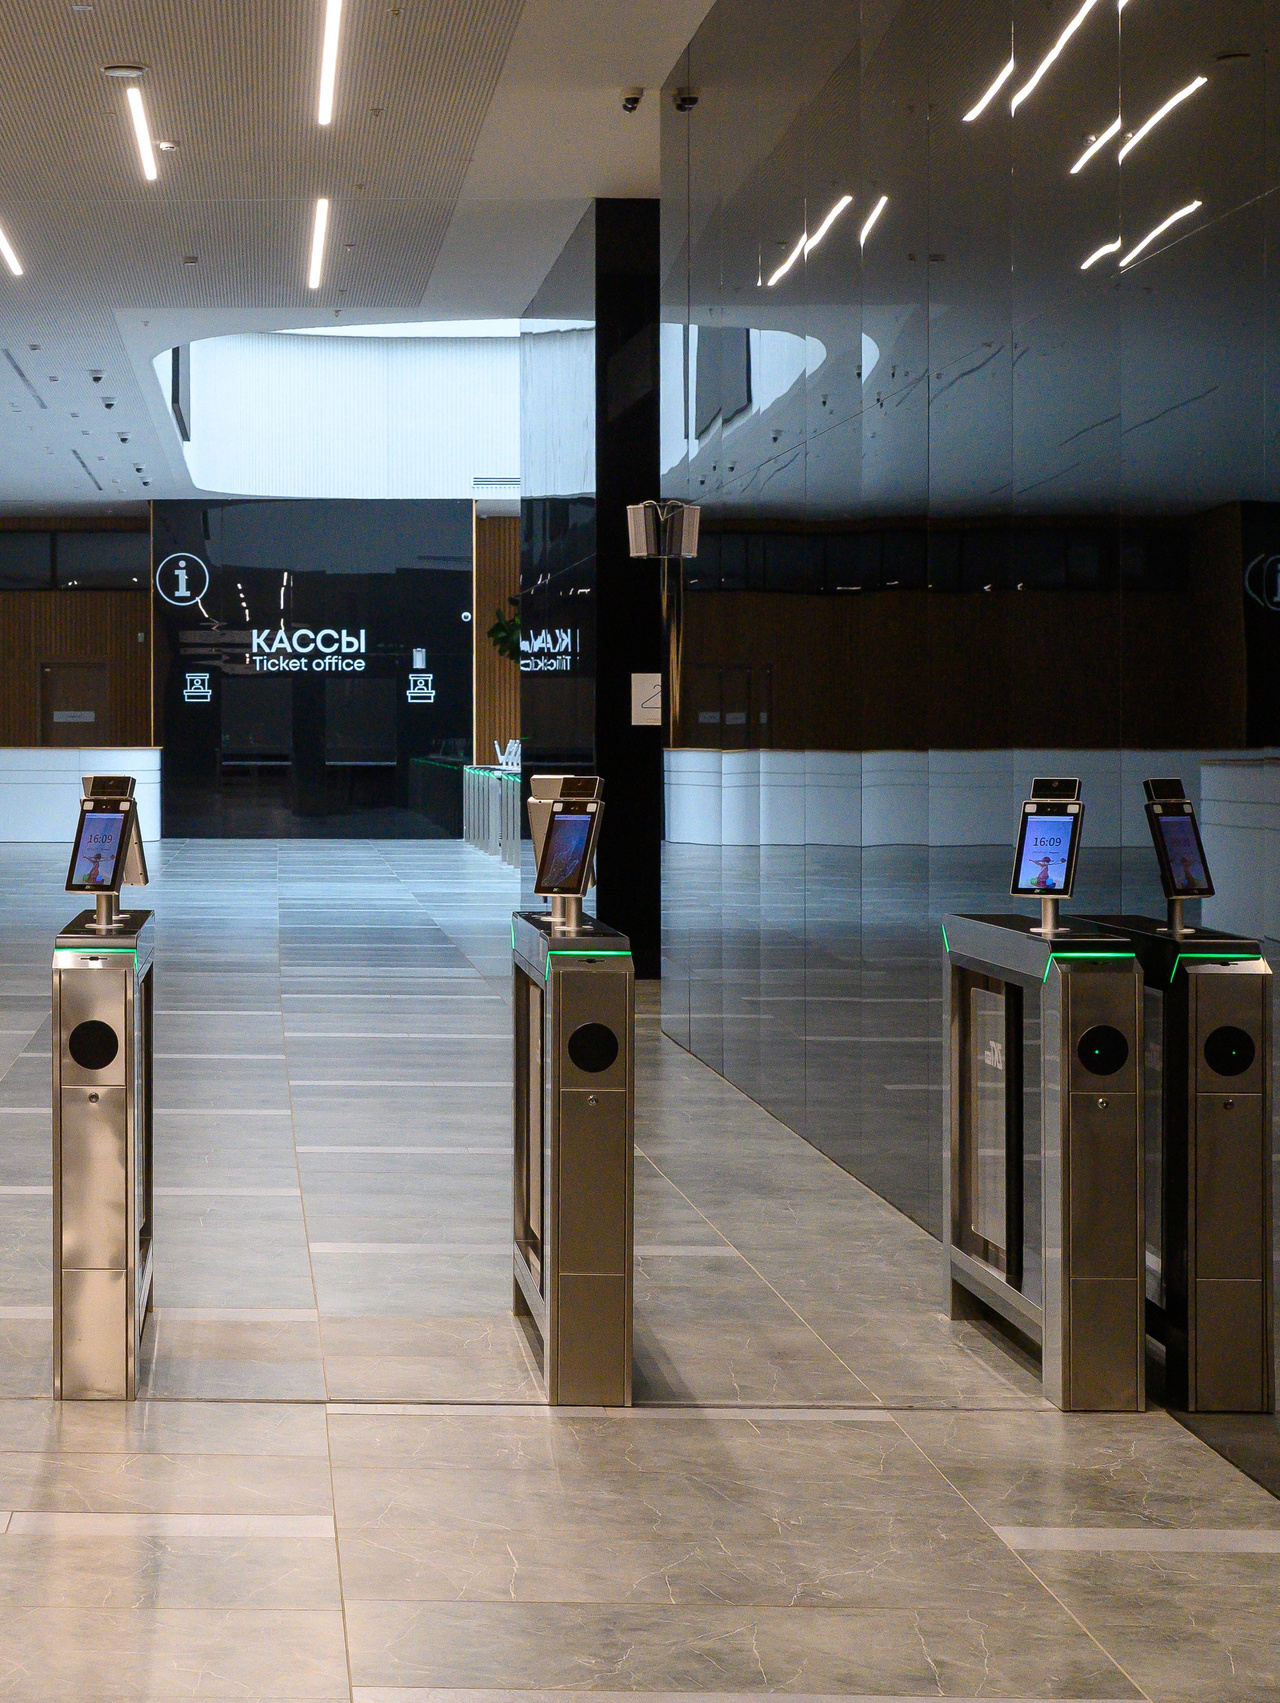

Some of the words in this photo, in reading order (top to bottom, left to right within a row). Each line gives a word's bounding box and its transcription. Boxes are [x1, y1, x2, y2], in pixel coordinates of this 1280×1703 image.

[251, 628, 366, 654] КАССЫ
[252, 655, 309, 672] Ticket
[311, 655, 366, 672] office
[87, 834, 114, 844] 16:09
[1032, 836, 1062, 847] 16:09
